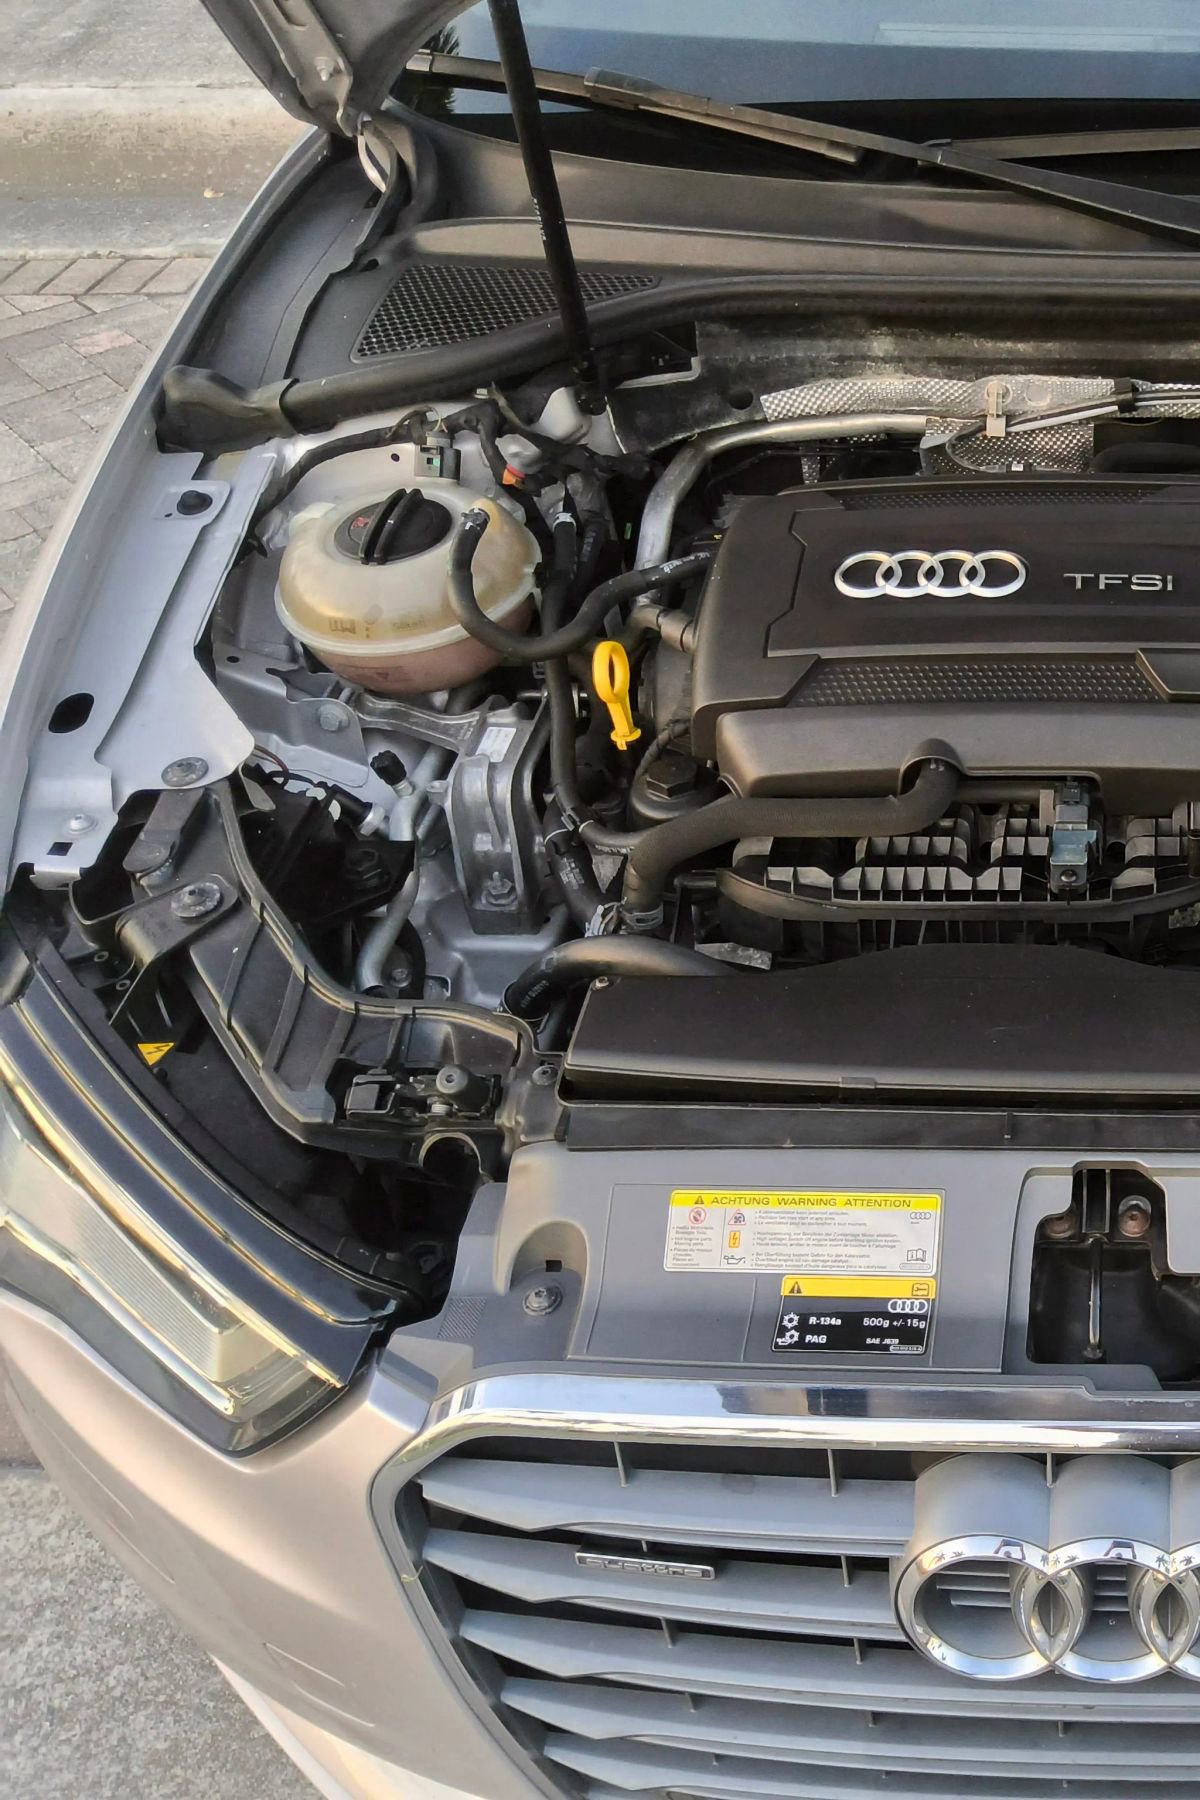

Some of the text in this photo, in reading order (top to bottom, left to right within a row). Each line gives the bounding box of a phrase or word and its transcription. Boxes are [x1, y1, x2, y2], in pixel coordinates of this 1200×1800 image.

[1063, 573, 1173, 591] TFSI
[711, 1196, 912, 1208] ACHTUNG WARNING ATTENTION
[808, 1316, 842, 1326] R-134a
[863, 1317, 890, 1328] 500g
[804, 1335, 827, 1344] PAG
